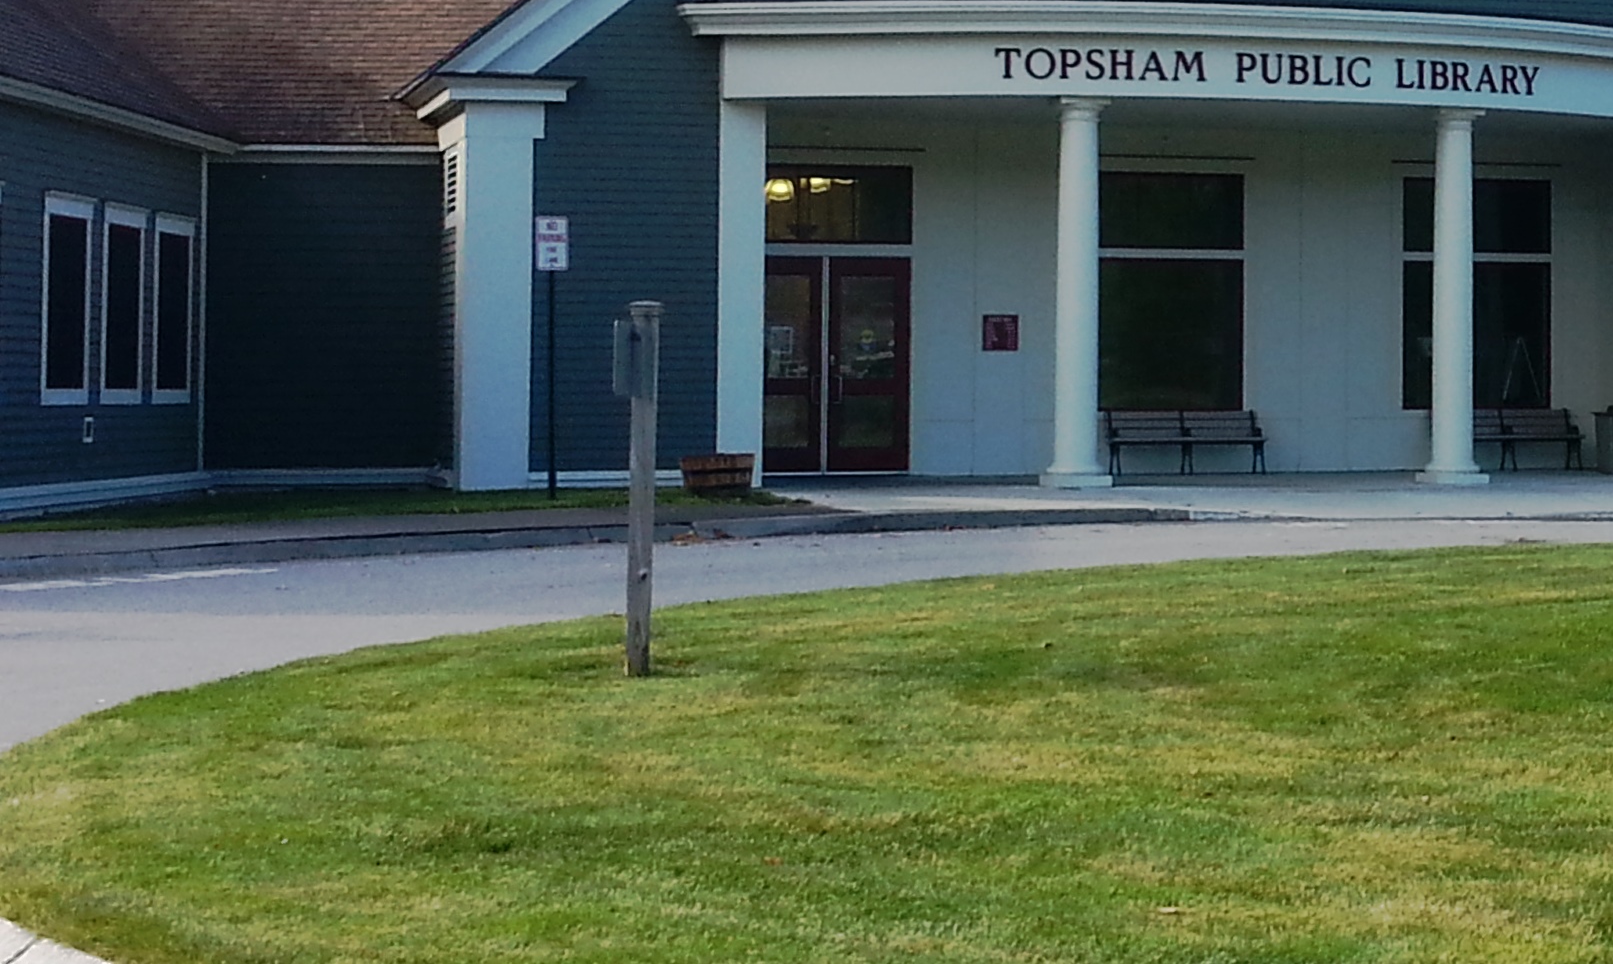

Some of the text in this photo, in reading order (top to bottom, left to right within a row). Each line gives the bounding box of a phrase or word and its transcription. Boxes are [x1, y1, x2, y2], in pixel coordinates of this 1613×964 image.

[994, 47, 1541, 96] TOPSHAM PUBLIC LIBRARY
